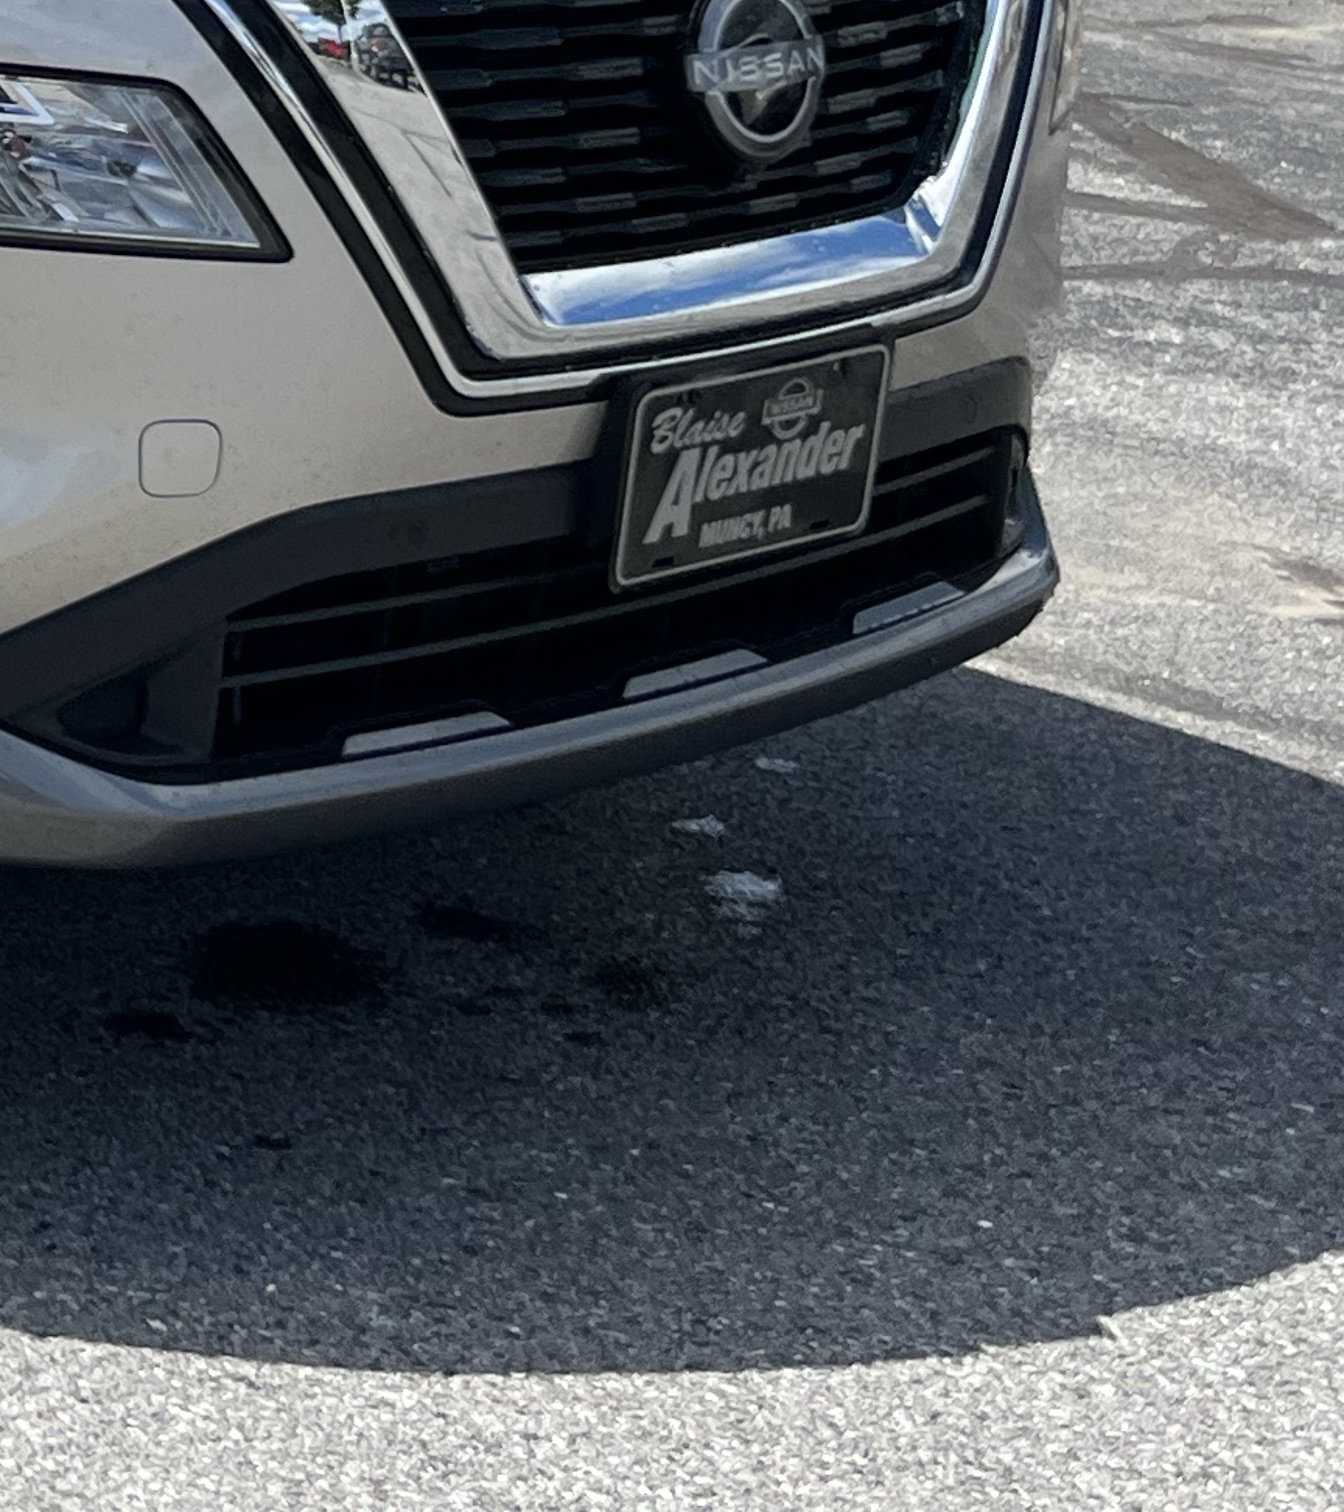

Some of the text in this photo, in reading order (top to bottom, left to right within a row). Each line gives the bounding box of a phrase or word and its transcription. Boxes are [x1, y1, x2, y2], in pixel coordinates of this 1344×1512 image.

[693, 47, 824, 85] NISSAN
[649, 406, 746, 455] Blaise
[642, 420, 866, 545] Alexander
